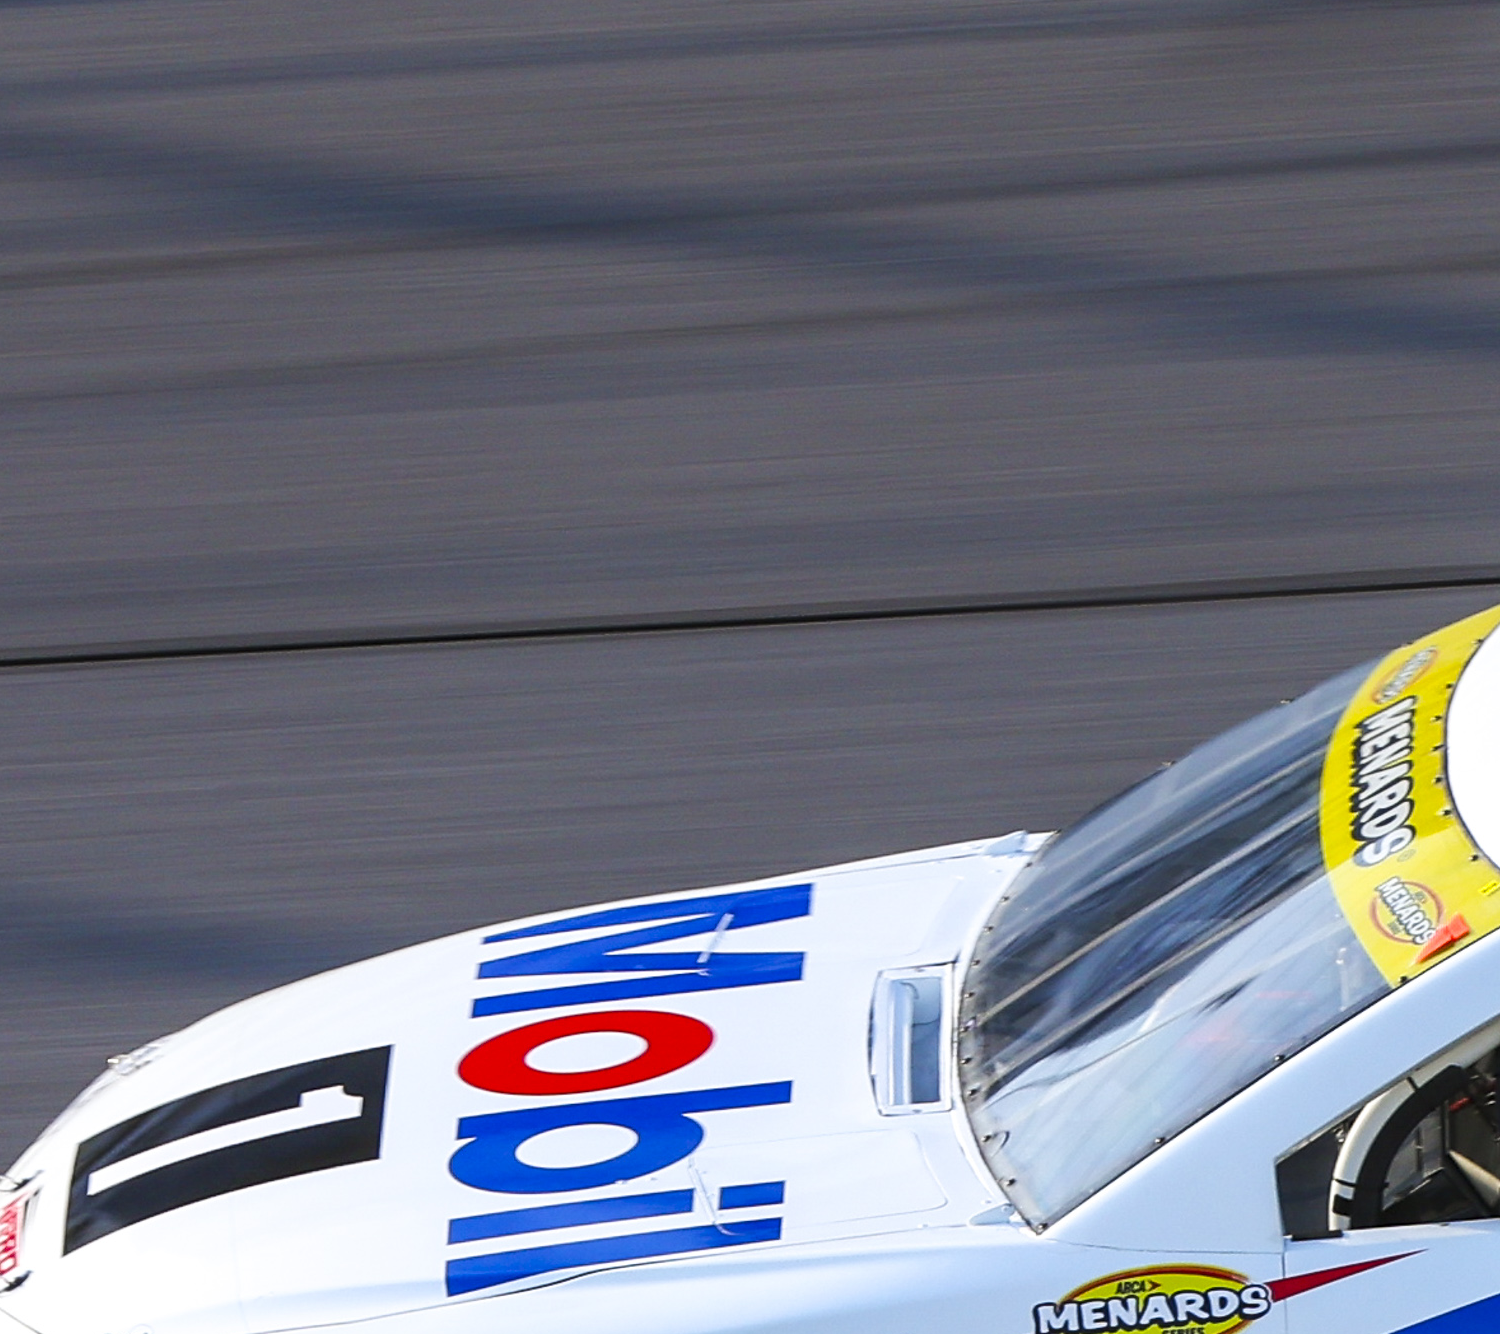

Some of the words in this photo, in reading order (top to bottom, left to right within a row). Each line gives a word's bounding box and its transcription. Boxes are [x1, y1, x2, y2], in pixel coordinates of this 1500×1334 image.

[1354, 696, 1417, 867] MENARDS
[1376, 876, 1436, 945] MENARDS
[88, 1086, 364, 1197] 1
[446, 882, 816, 1297] Mobil
[1115, 1280, 1146, 1294] ARCA
